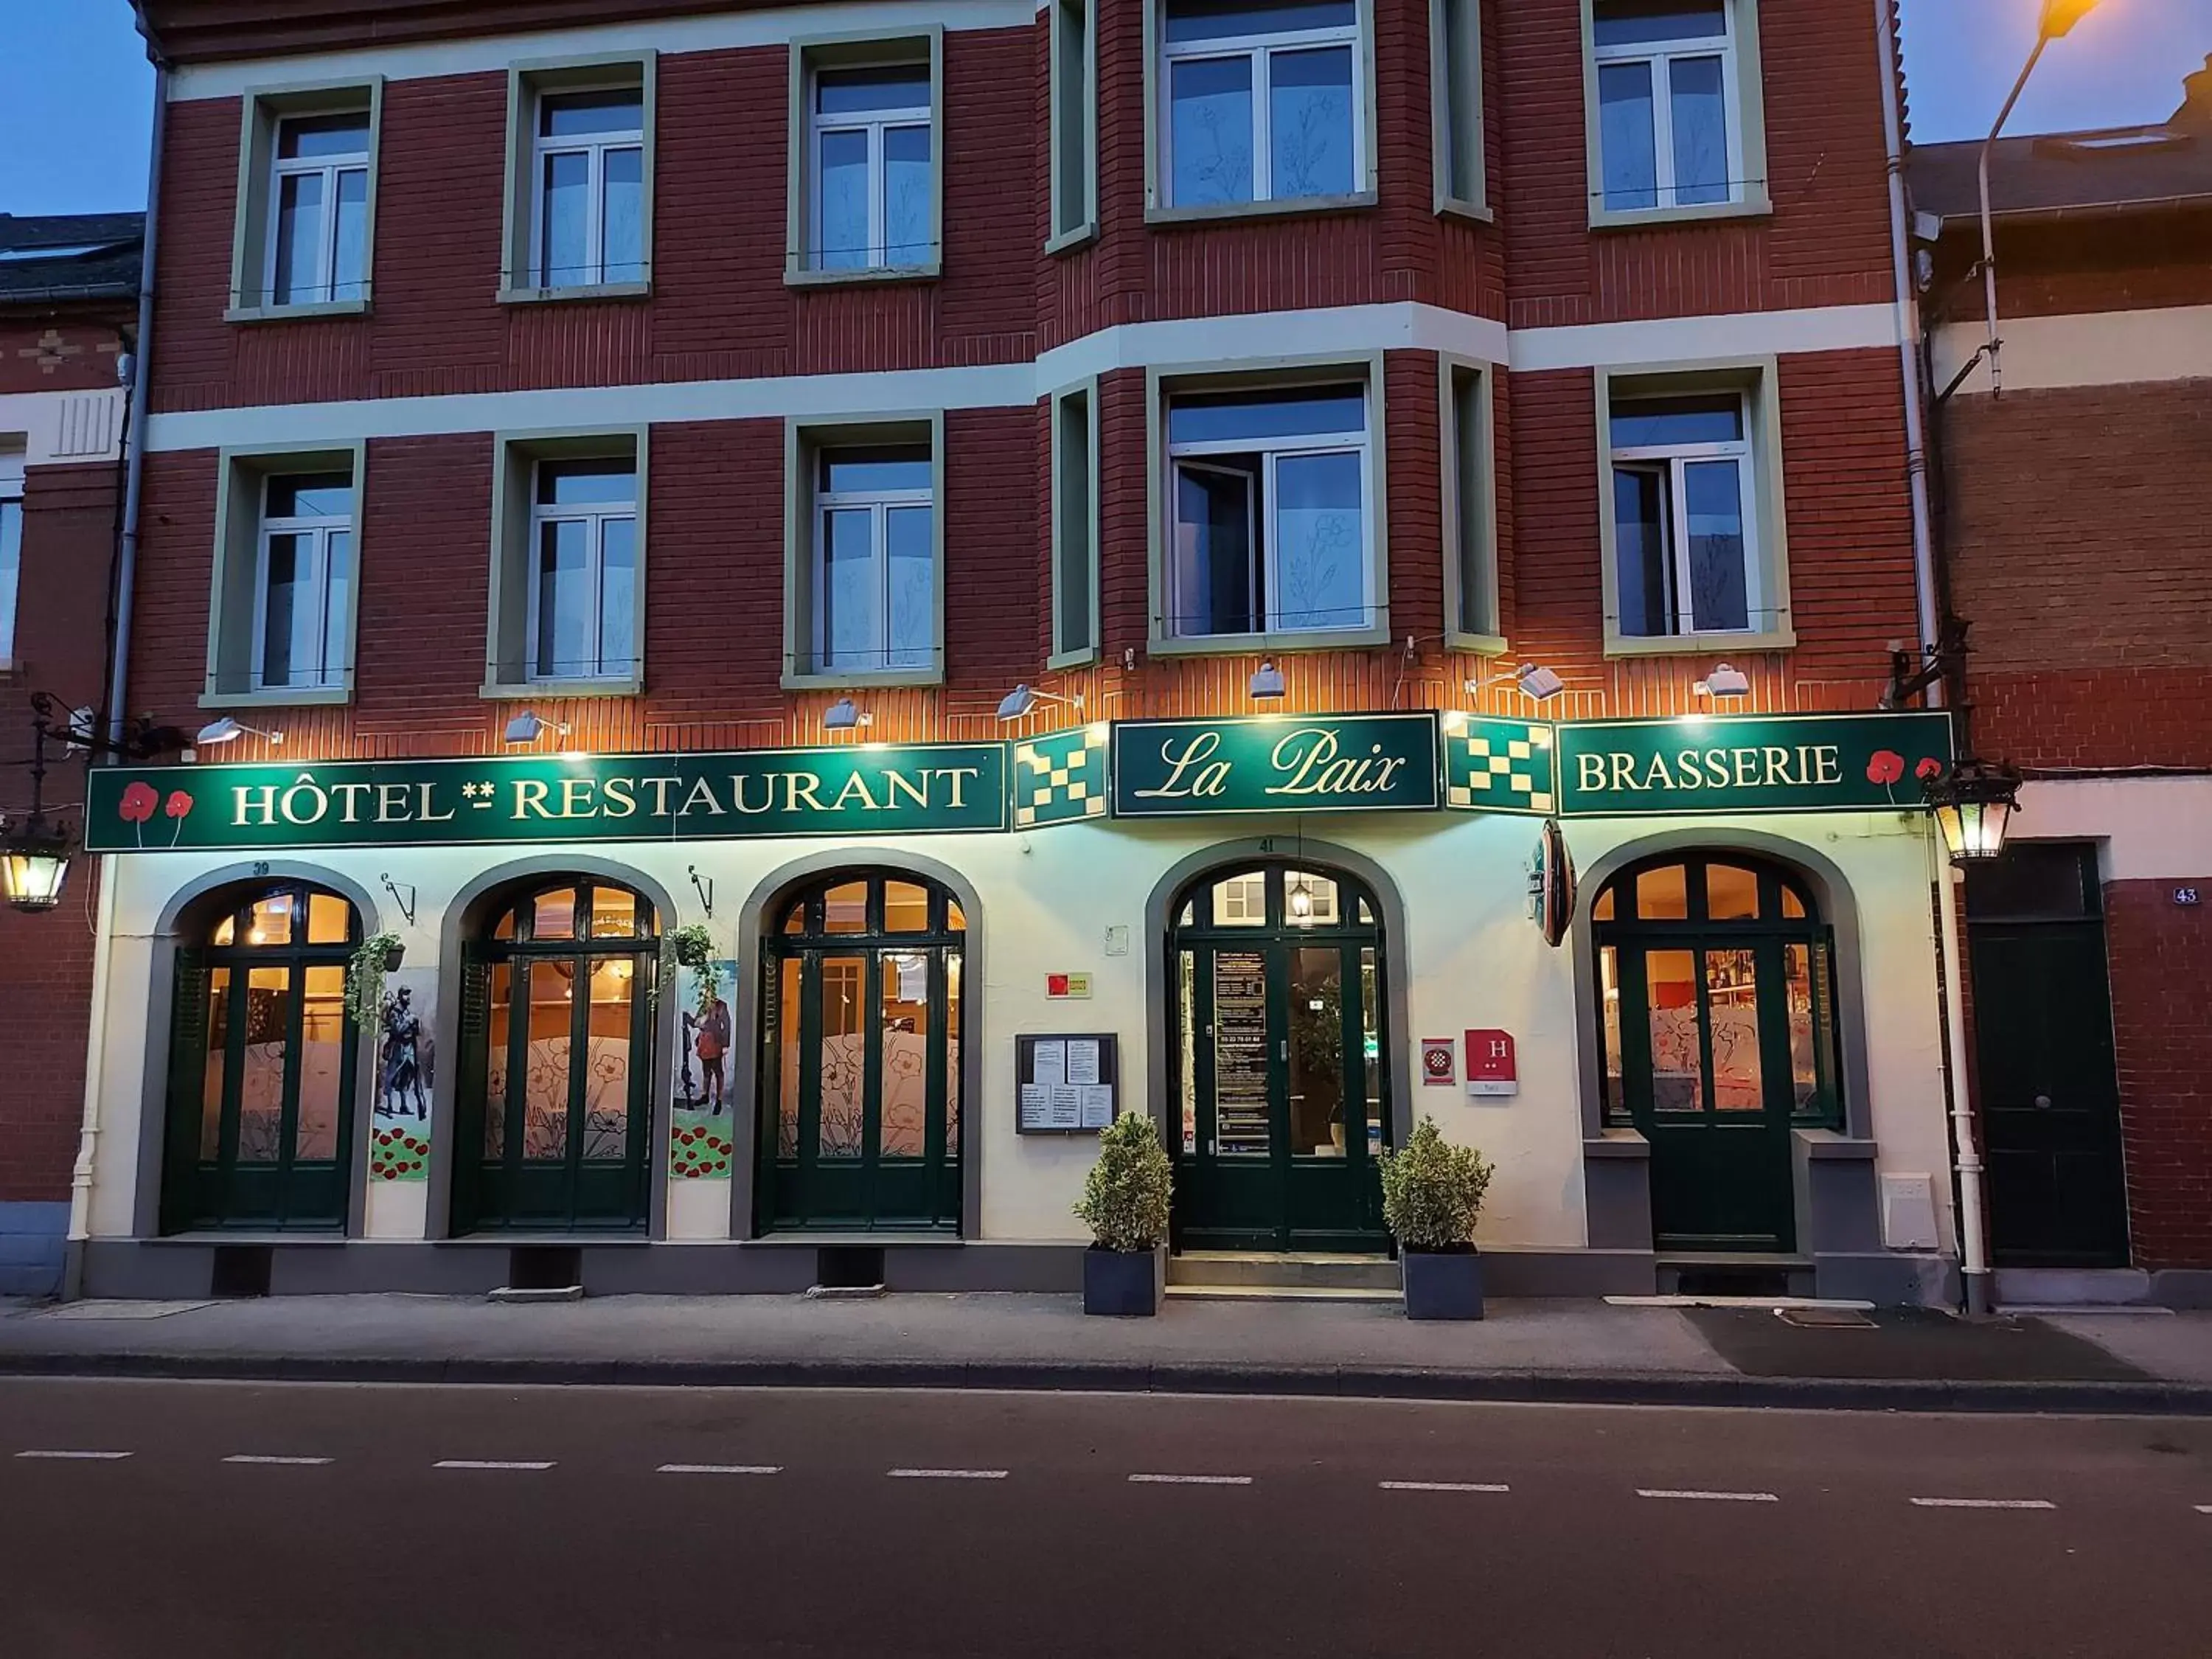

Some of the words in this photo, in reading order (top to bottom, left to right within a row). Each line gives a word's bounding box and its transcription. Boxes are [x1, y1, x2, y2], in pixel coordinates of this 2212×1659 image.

[1133, 731, 1233, 798] La
[1264, 728, 1407, 796] Paix
[1575, 745, 1843, 793] BRASSERIE
[229, 773, 456, 827] HÔTEL
[509, 768, 979, 820] RESTAURANT
[1259, 838, 1274, 852] 41
[253, 861, 269, 875] 39
[2177, 888, 2197, 902] 43
[1489, 1040, 1507, 1058] H
